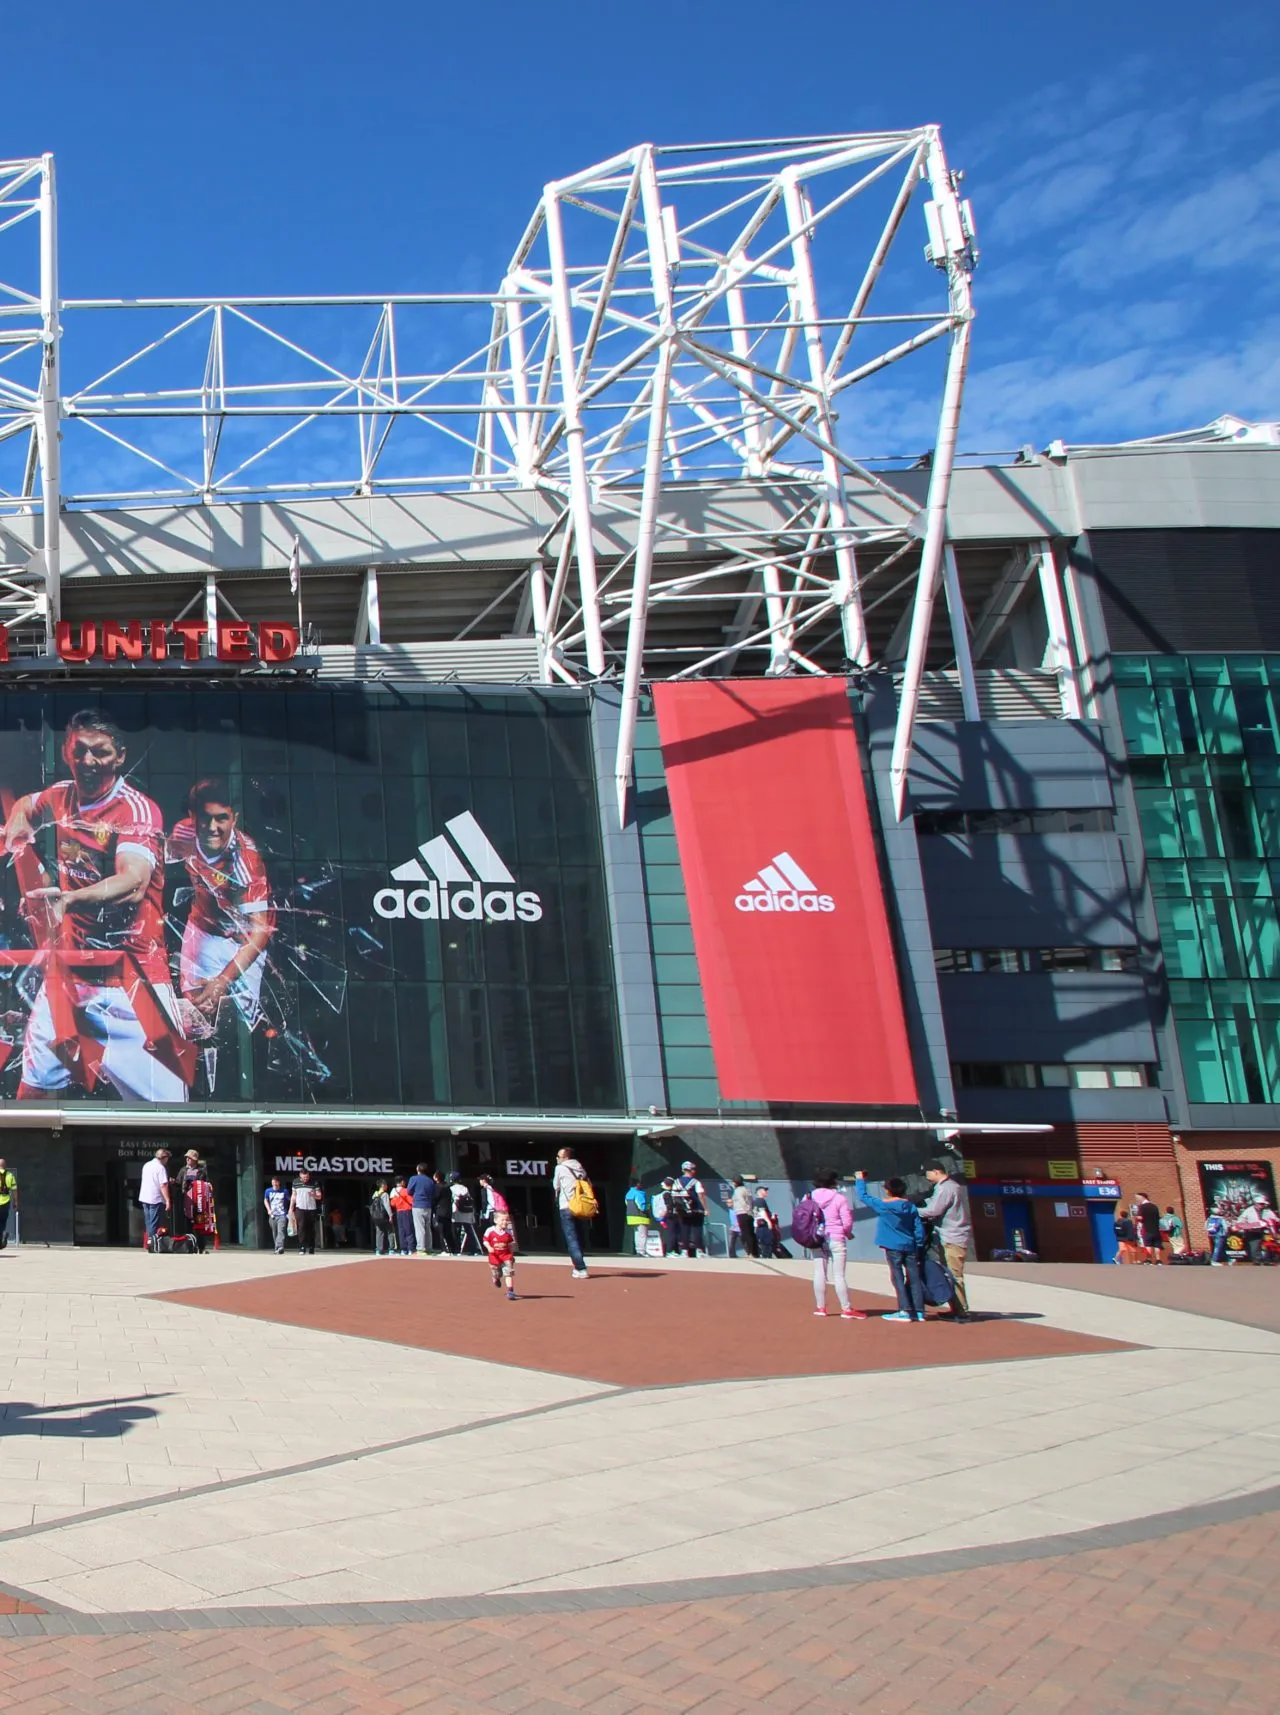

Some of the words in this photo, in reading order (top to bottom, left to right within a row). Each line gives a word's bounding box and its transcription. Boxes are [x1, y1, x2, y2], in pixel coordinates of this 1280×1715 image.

[55, 619, 300, 662] UNITED
[373, 880, 543, 922] adidas
[734, 889, 836, 912] adidas
[275, 1156, 394, 1173] MEGASTORE
[506, 1160, 549, 1175] EXIT
[1204, 1163, 1224, 1171] THIS
[1098, 1186, 1118, 1196] E36
